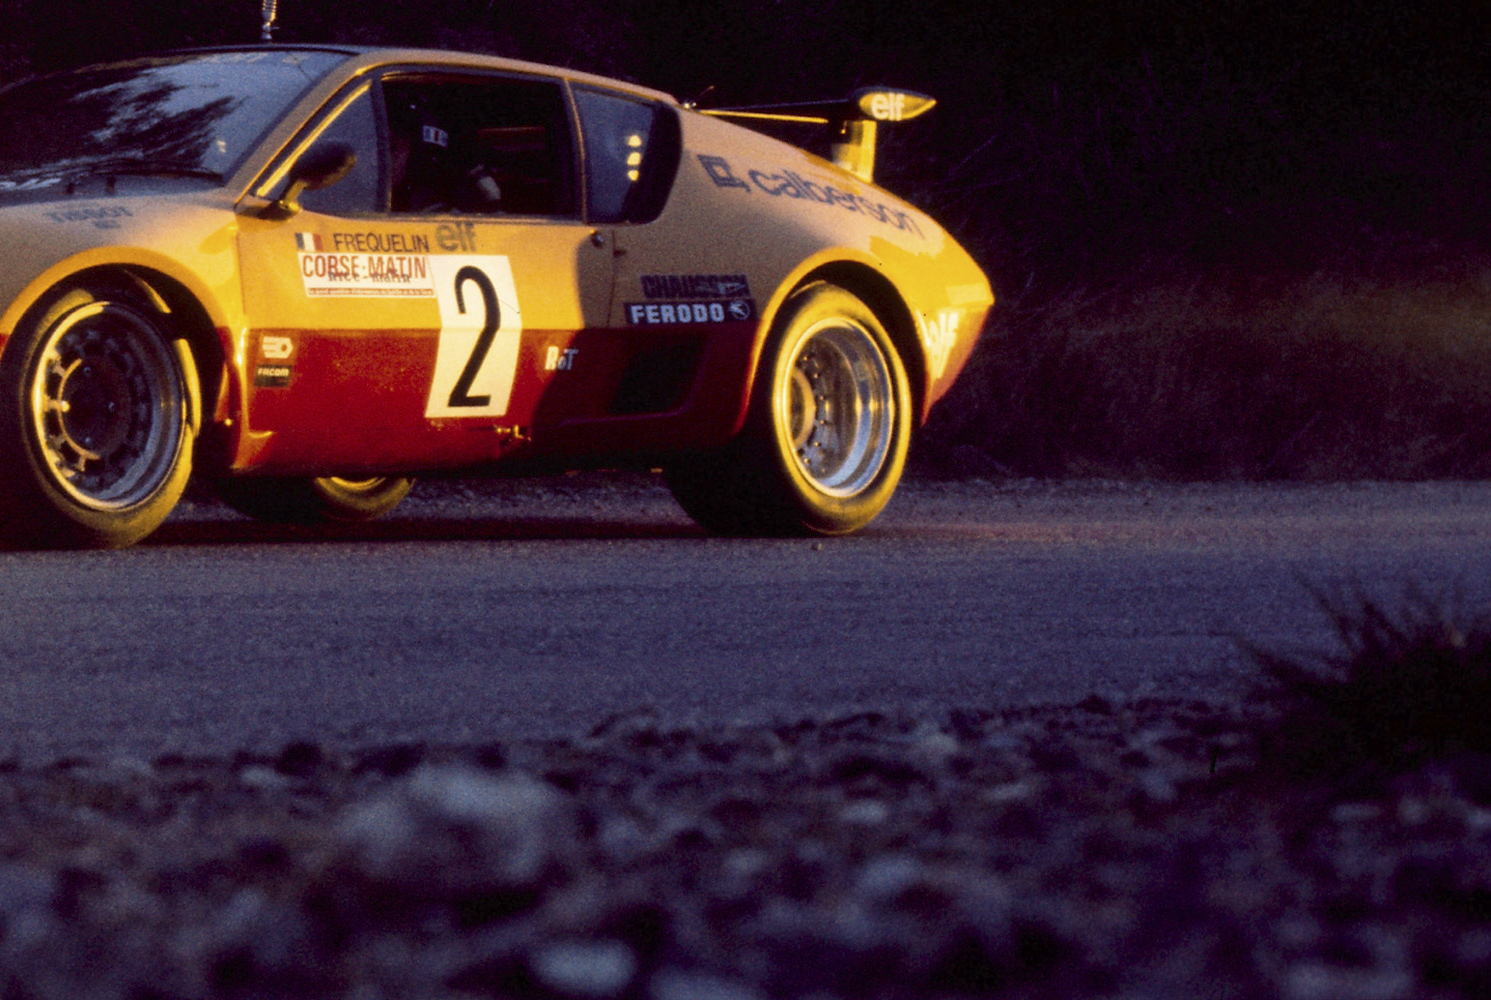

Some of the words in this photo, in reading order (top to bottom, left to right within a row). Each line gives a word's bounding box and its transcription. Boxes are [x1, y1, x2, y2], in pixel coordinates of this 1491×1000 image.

[871, 92, 904, 121] elf
[333, 232, 430, 253] FREQUELIN
[436, 222, 477, 252] elf
[630, 303, 725, 324] FERODO
[447, 265, 501, 407] 2
